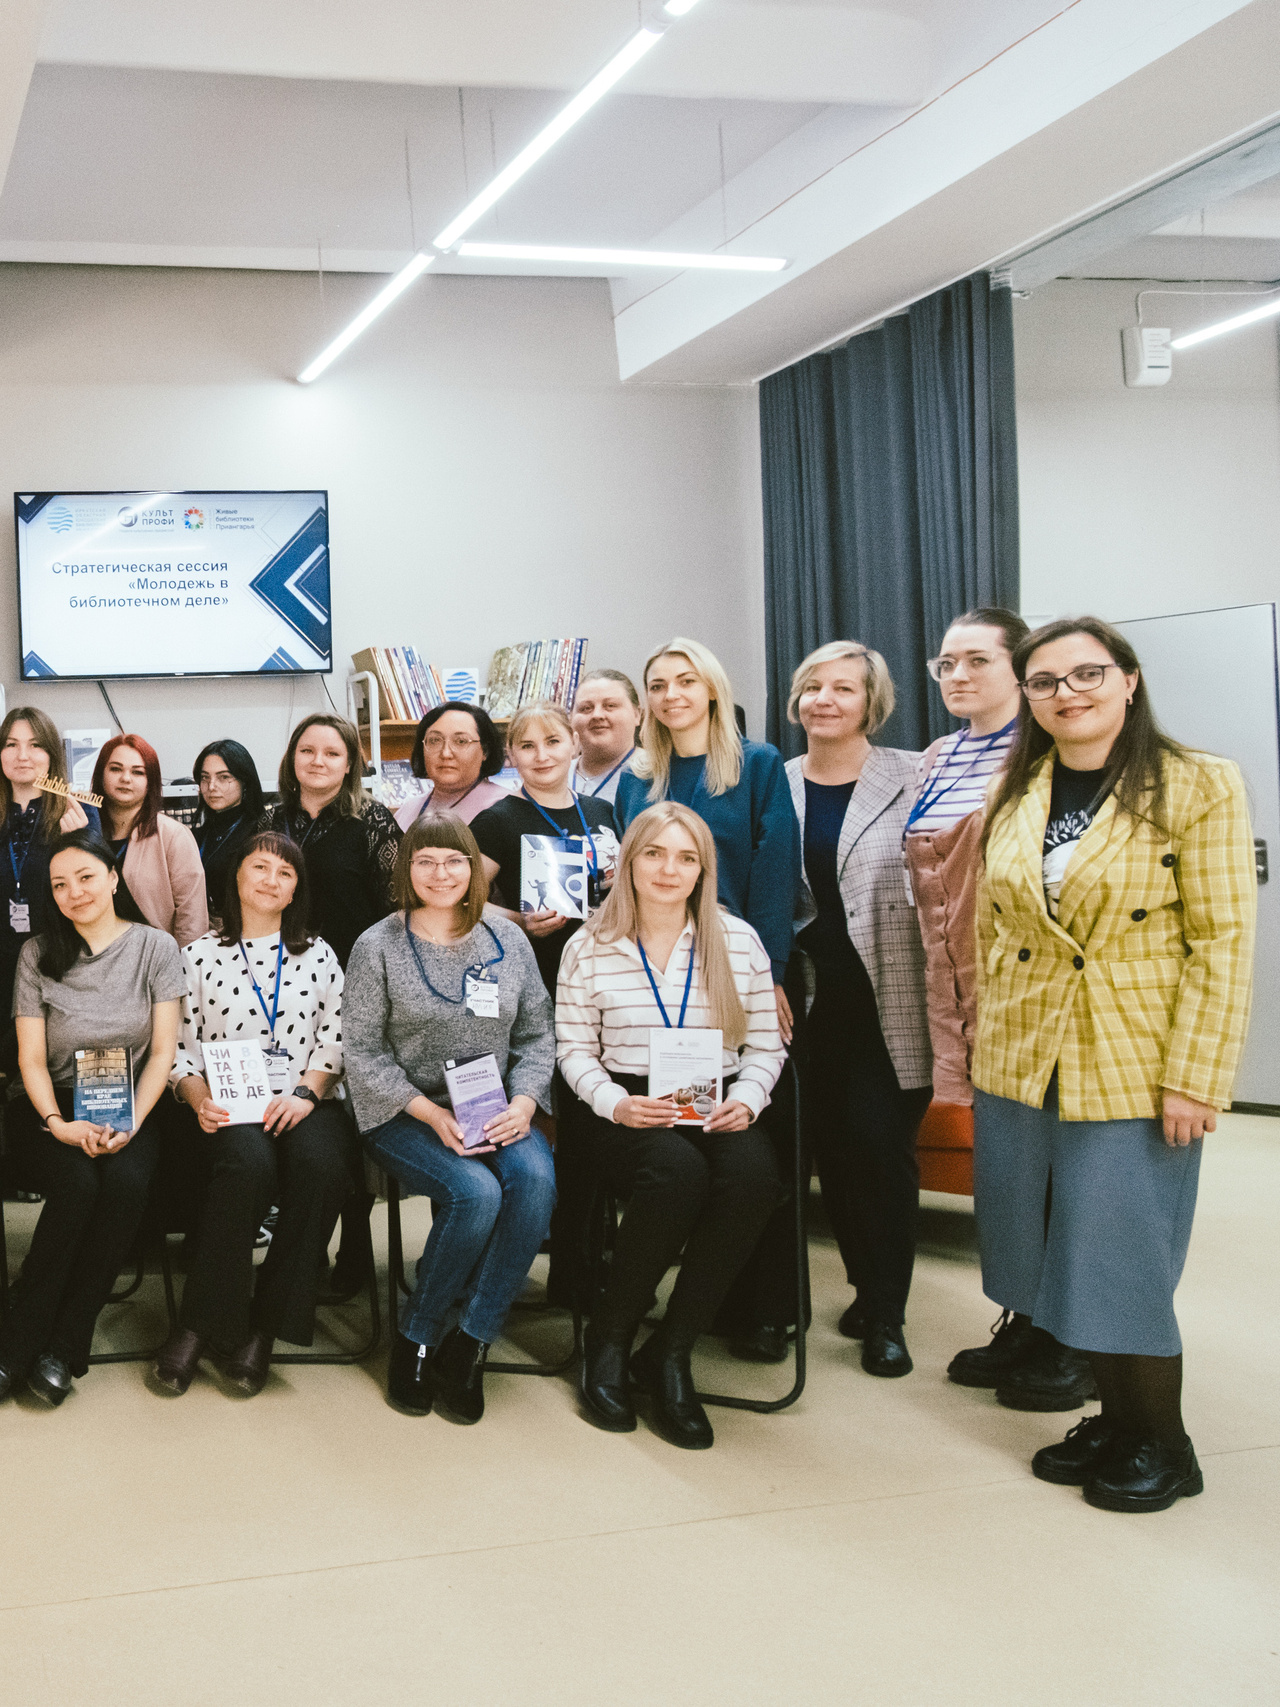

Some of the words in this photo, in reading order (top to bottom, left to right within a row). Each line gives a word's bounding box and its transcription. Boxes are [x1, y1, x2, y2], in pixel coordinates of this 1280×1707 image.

[142, 509, 173, 517] КУЛЬТ
[215, 523, 255, 531] Приангарья
[52, 562, 171, 576] Стратегическая
[177, 562, 228, 572] сессия
[128, 578, 215, 591] «Молодежь
[220, 579, 228, 588] в
[69, 596, 180, 608] библиотечном
[185, 596, 229, 608] деле»
[210, 1048, 230, 1059] ЧИ
[242, 1046, 250, 1057] В
[214, 1062, 232, 1072] ТА
[240, 1059, 258, 1070] ГО
[216, 1074, 235, 1086] ТЕ
[455, 1070, 488, 1080] ЧИТАТЕЛЬСКАЯ
[456, 1074, 495, 1084] КОМПЕТЕНТНОСТЬ
[220, 1088, 238, 1099] ЛЬ
[246, 1086, 266, 1099] ДЕ
